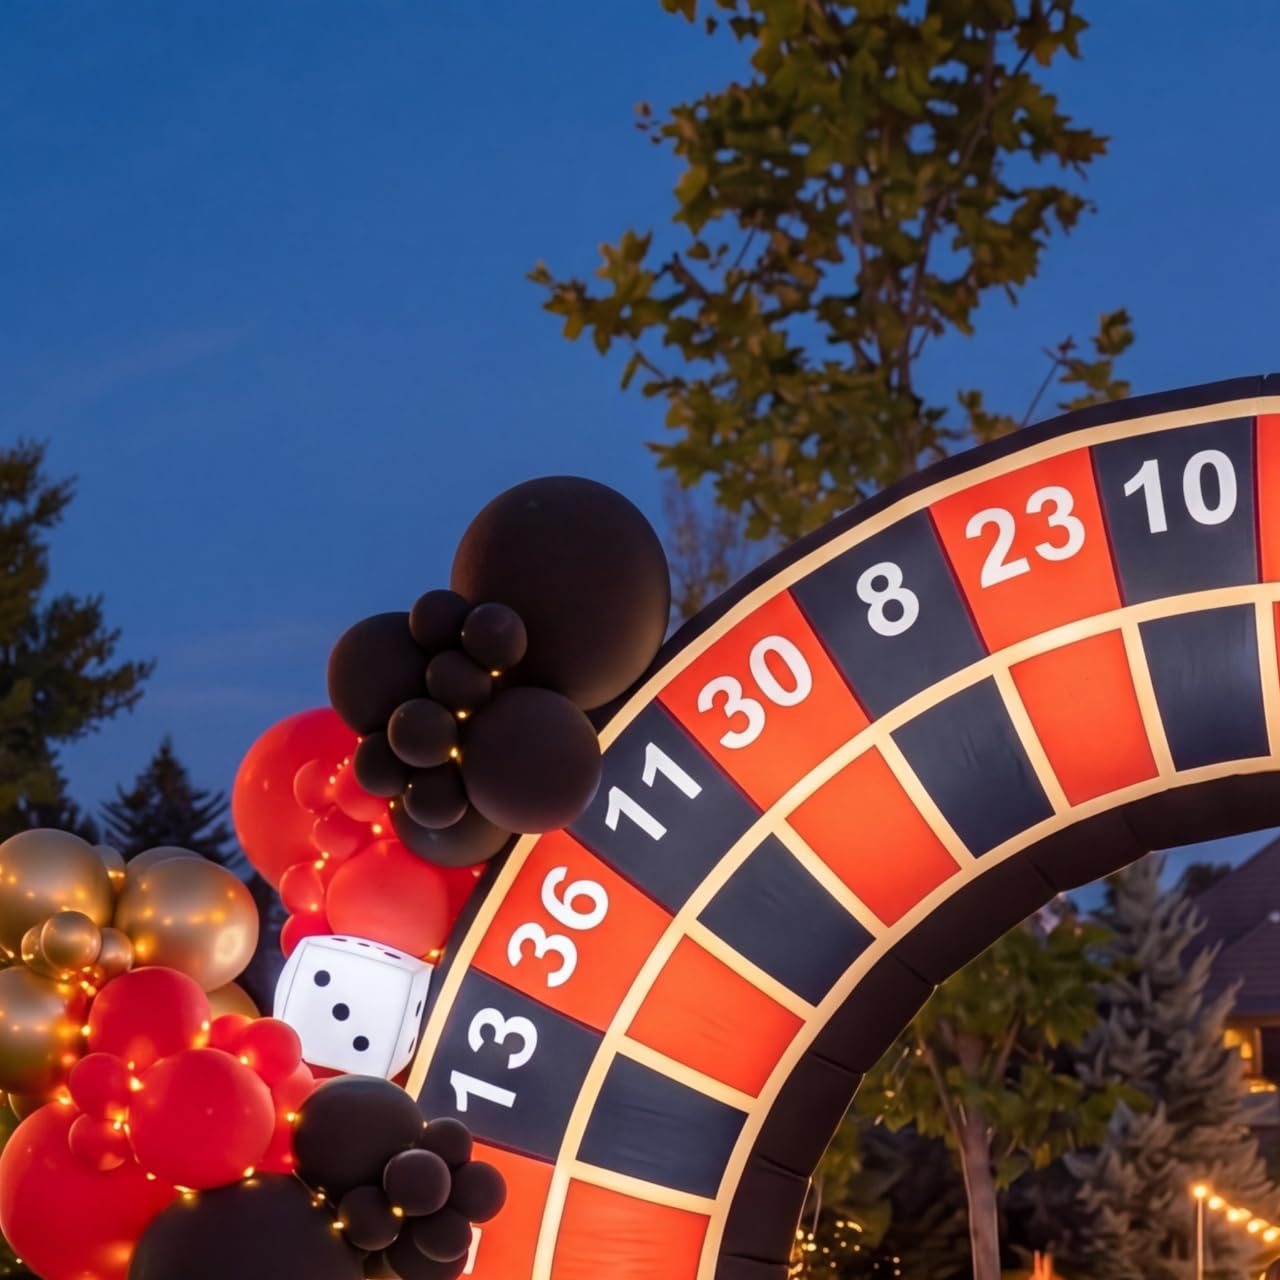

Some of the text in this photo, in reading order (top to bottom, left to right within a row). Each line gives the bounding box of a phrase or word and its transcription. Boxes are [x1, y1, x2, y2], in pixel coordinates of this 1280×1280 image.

[966, 486, 1085, 588] 23
[1123, 449, 1238, 534] 10
[856, 561, 920, 637] 8
[698, 636, 812, 749] 30
[604, 741, 703, 841] 11
[507, 867, 609, 987] 36
[449, 1007, 538, 1113] 13
